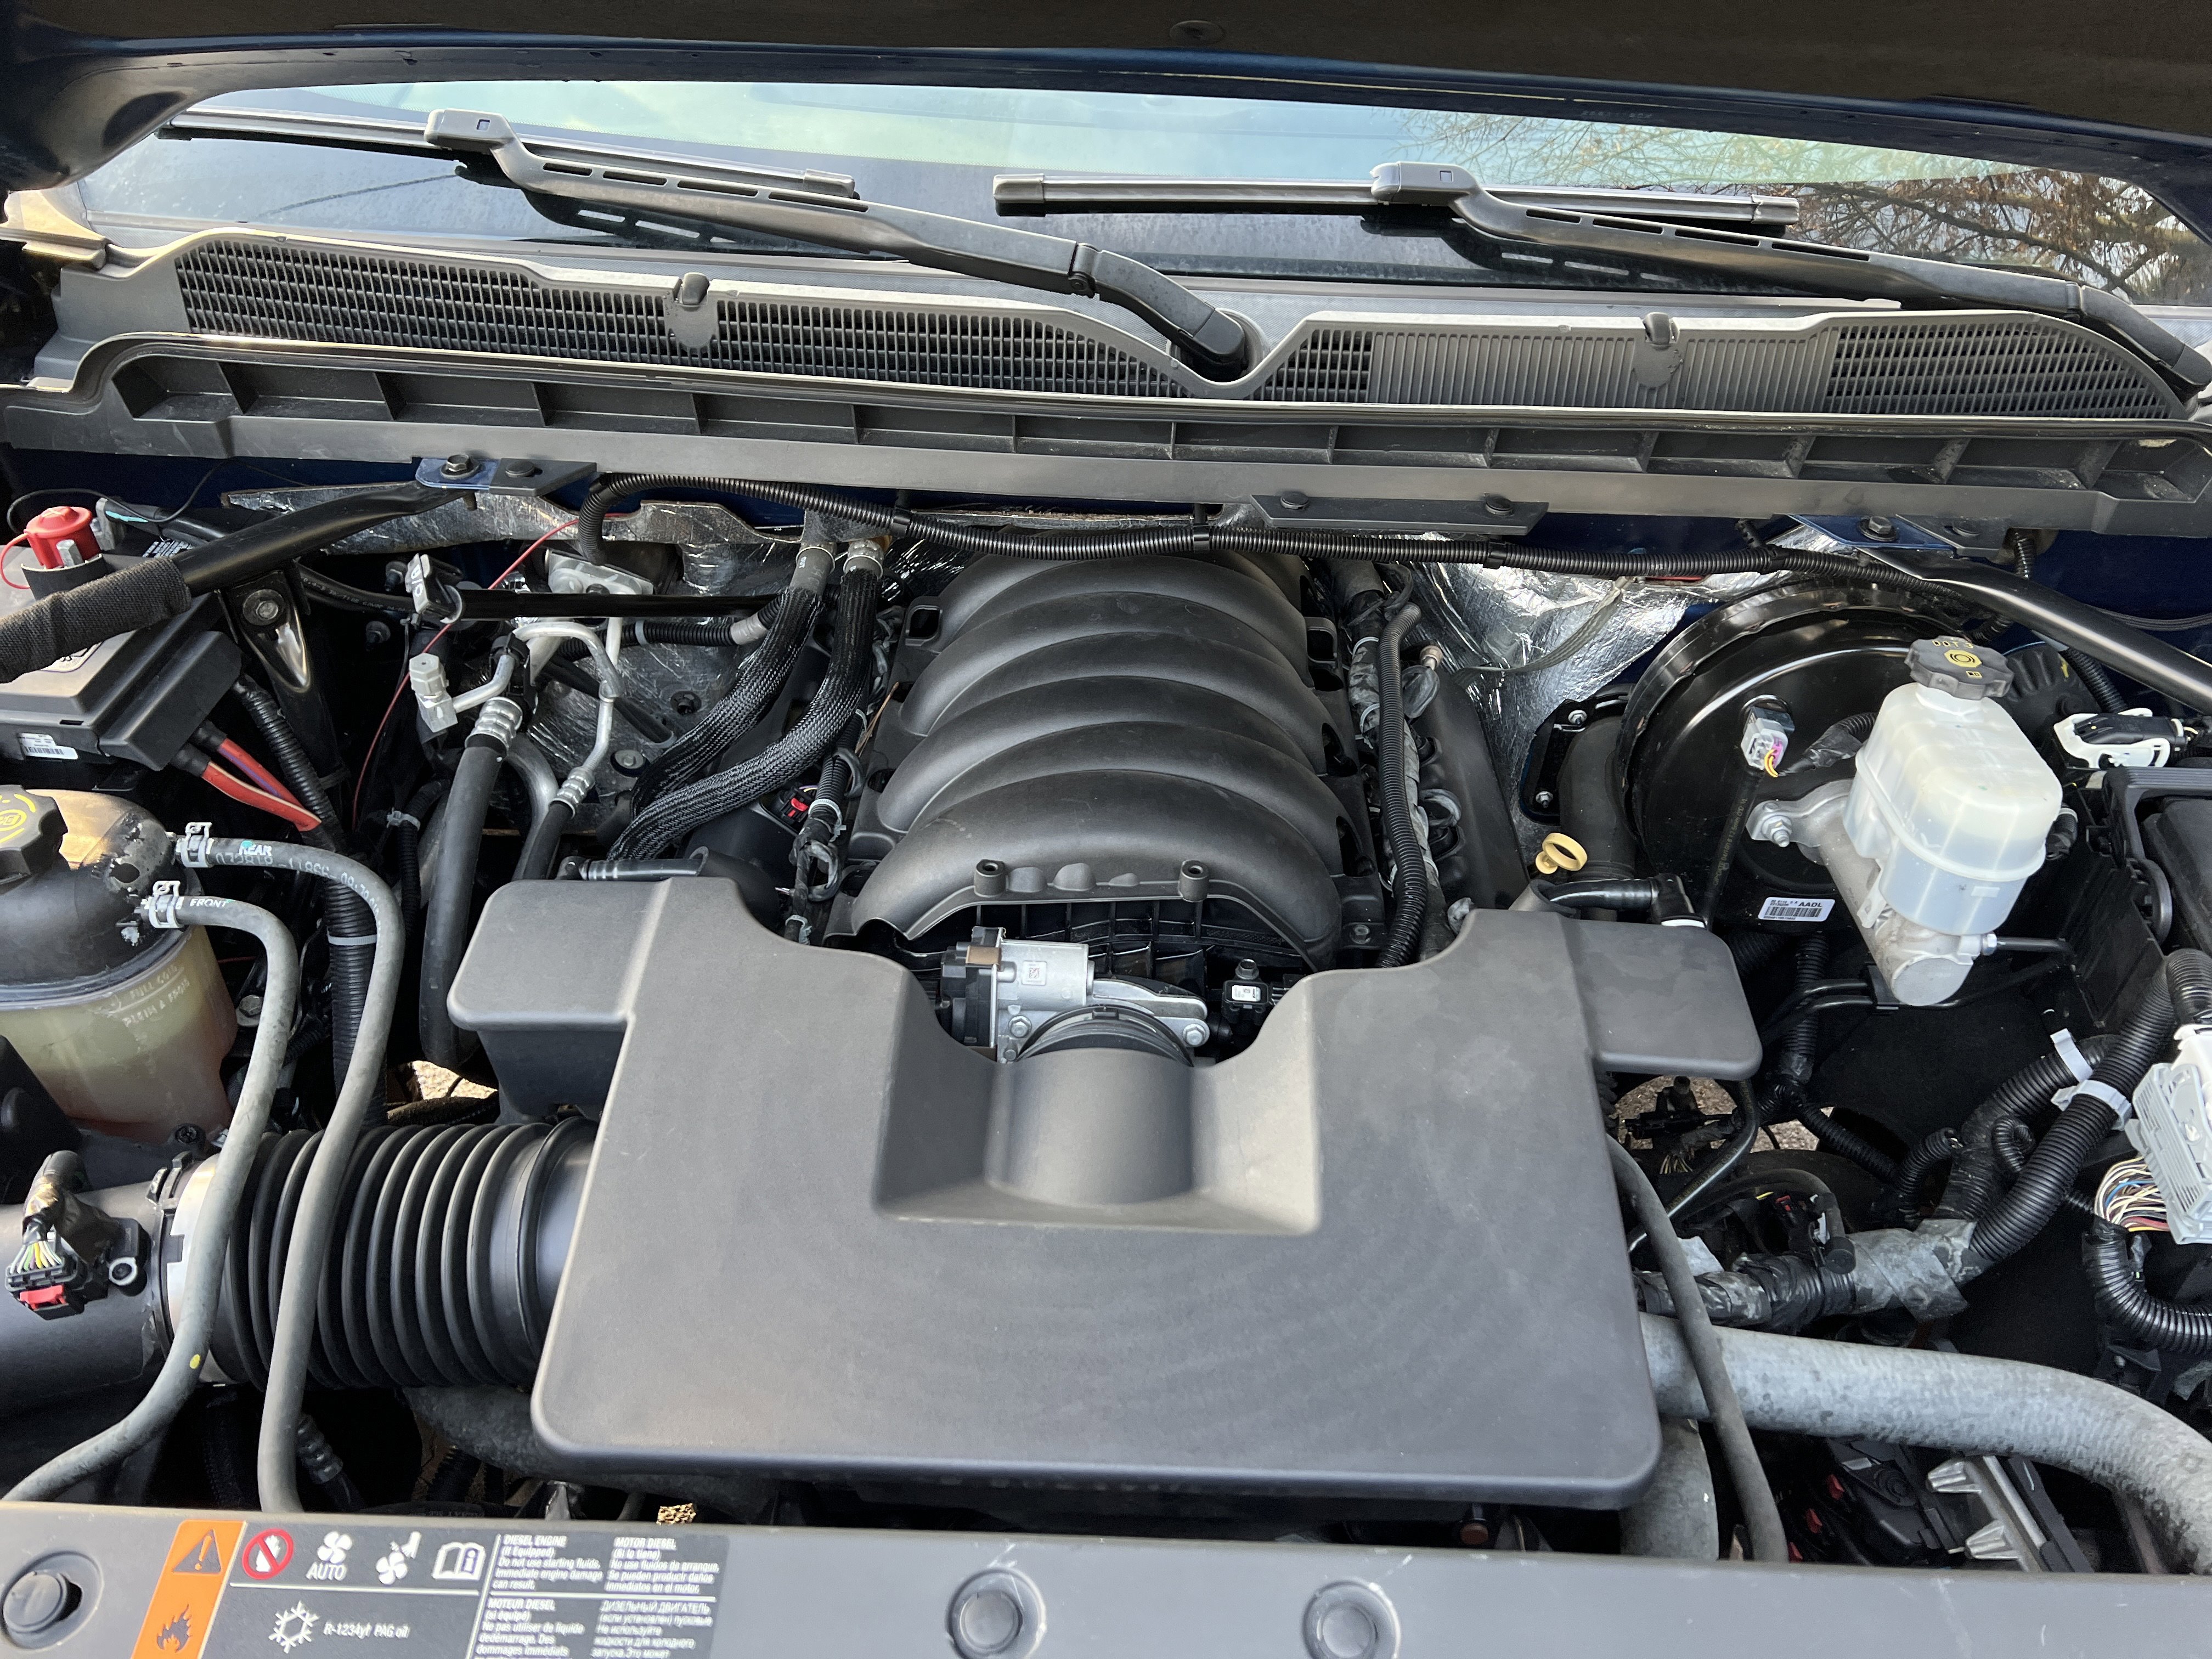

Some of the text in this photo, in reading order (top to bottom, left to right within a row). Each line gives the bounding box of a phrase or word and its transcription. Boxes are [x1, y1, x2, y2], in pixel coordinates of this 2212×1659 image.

[1932, 640, 1959, 648] DOT
[190, 898, 229, 907] FRONT
[504, 1534, 567, 1547] DIESEL ENGINE
[614, 1537, 676, 1550] MOTOR DIESEL
[513, 1546, 556, 1558] Equipped)
[636, 1549, 662, 1561] tiene)
[499, 1558, 601, 1570] Do not use starting fluids.
[610, 1559, 719, 1573] No use fluidos de arranque.
[306, 1562, 347, 1581] AUTO
[495, 1568, 603, 1583] Immediate engine damage
[607, 1570, 620, 1580] Se
[621, 1571, 651, 1582] pueden
[652, 1572, 686, 1583] producir
[492, 1579, 535, 1589] can result.
[652, 1583, 663, 1593] en
[665, 1583, 673, 1593] el
[674, 1584, 699, 1594] motor.
[488, 1598, 556, 1611] MOTEUR DIESEL
[600, 1600, 711, 1615] ДИЗЕЛЬНЫЙ ДВИГАТЕЛЬ
[374, 1622, 395, 1638] PAG
[395, 1623, 410, 1639] oil
[482, 1621, 585, 1636] Ne pas utiliser de liquide
[596, 1624, 609, 1634] Не
[538, 1633, 556, 1645] Des
[634, 1637, 651, 1647] для
[476, 1644, 523, 1657] dommages
